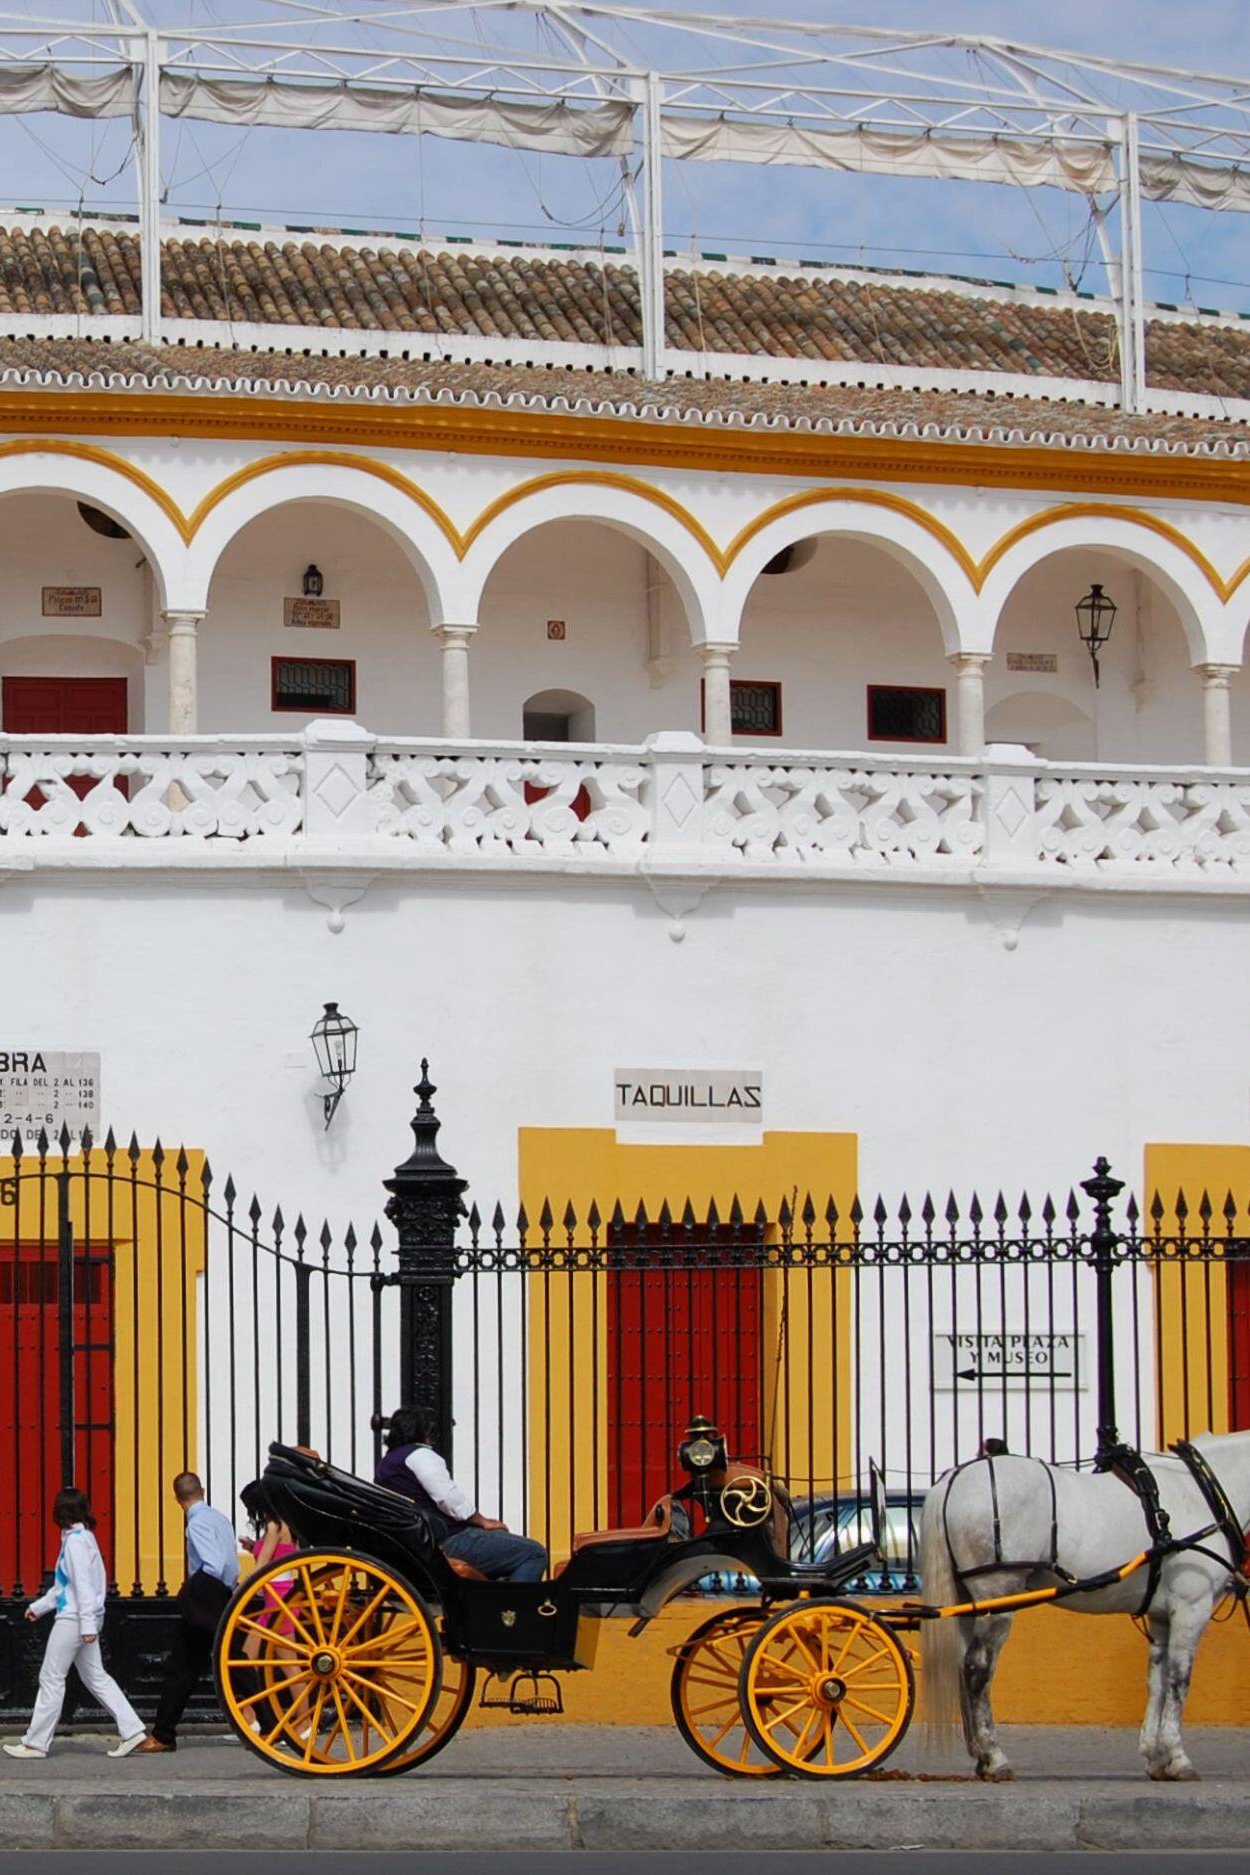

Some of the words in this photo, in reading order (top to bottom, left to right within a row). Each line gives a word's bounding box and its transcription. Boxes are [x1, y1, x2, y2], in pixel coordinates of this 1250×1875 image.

[10, 1078, 28, 1087] FILA
[33, 1078, 48, 1087] DEL
[53, 1078, 59, 1087] 2
[63, 1078, 75, 1087] AL
[78, 1078, 94, 1087] 136
[78, 1089, 94, 1098] 138
[616, 1083, 761, 1108] TAQUILLAS
[78, 1100, 94, 1109] 140
[0, 1179, 18, 1206] 6
[969, 1352, 981, 1364] Y
[987, 1351, 1049, 1364] MUSEO
